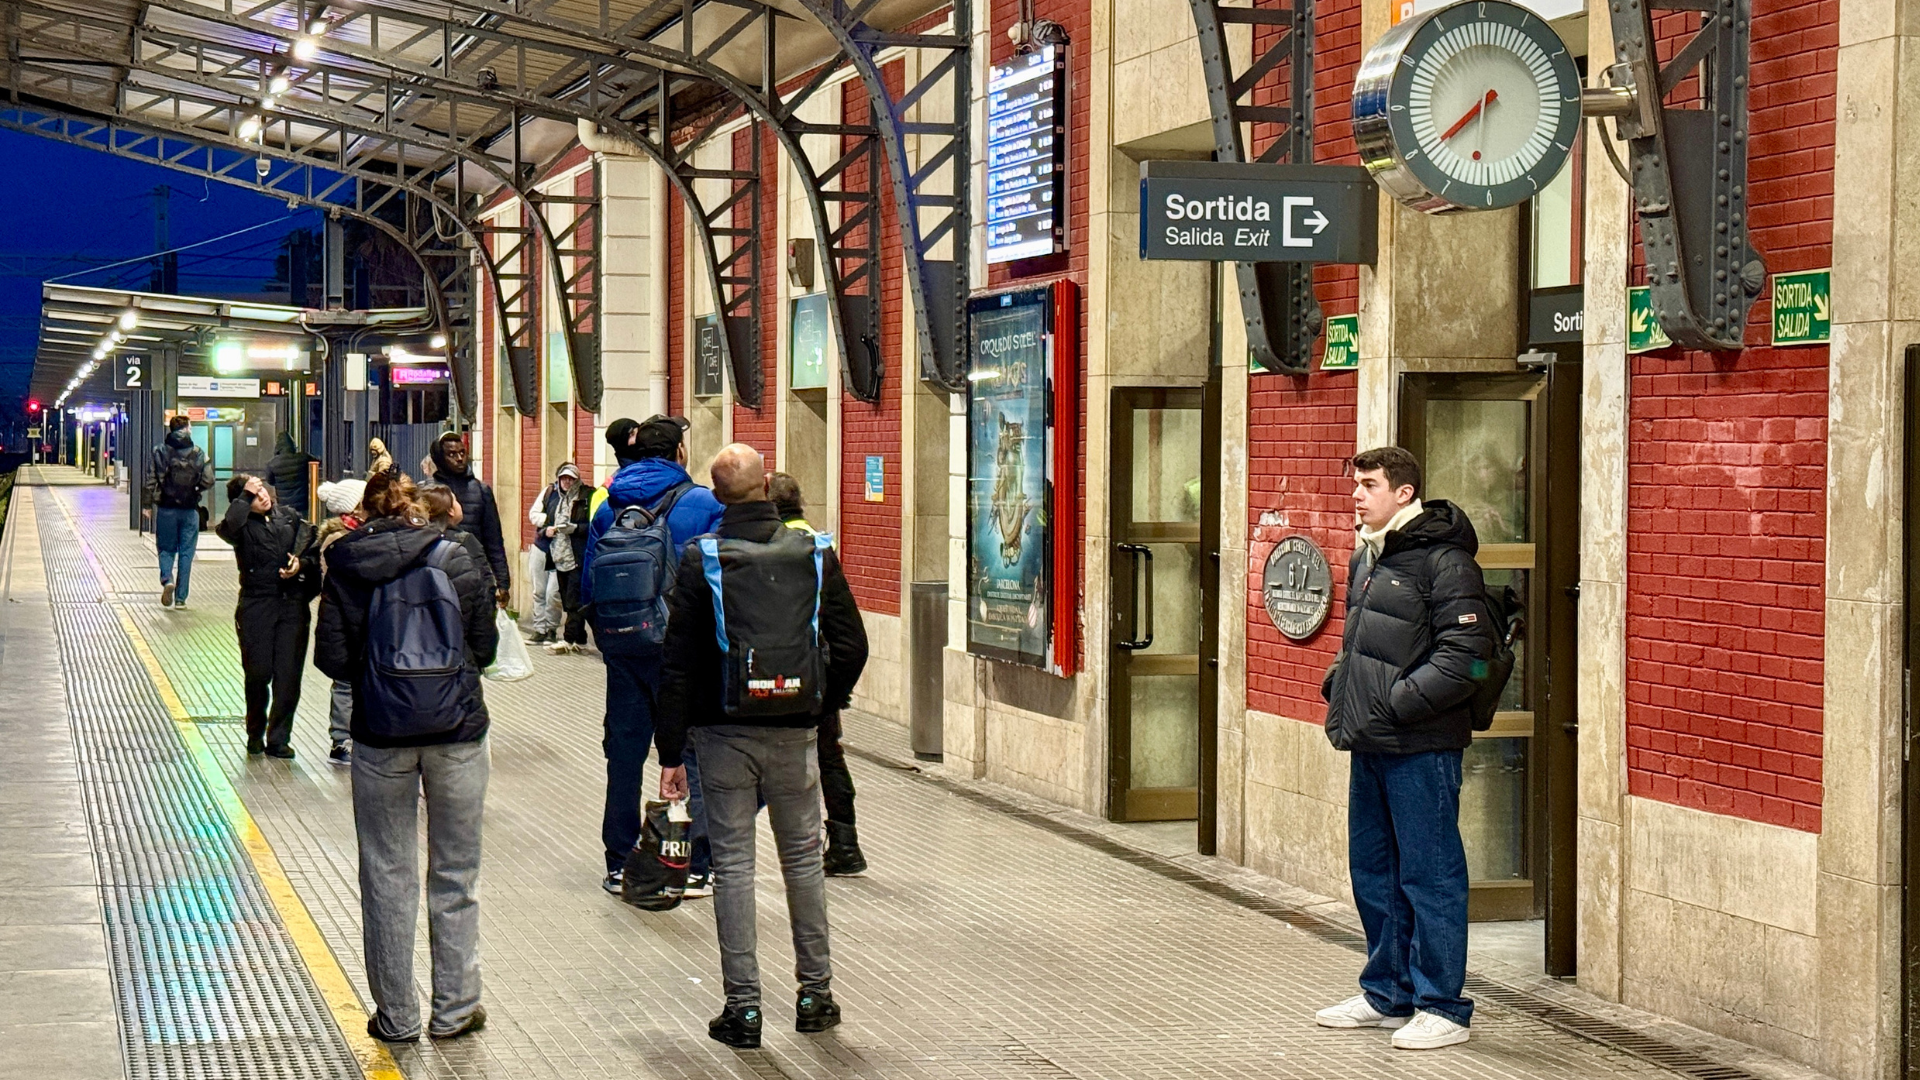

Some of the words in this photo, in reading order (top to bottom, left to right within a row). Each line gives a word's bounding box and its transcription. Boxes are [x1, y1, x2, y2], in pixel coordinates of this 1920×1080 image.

[1478, 1, 1486, 18] 12
[1401, 54, 1416, 67] 10
[1551, 46, 1565, 59] 2
[1390, 104, 1406, 112] 9
[1404, 149, 1418, 161] 8
[1554, 141, 1569, 152] 4
[1440, 180, 1451, 195] 7
[1527, 175, 1538, 190] 5
[1486, 189, 1493, 206] 6
[1166, 193, 1270, 222] Sortida
[1165, 227, 1224, 247] Salida
[1234, 228, 1271, 247] Exit
[1776, 282, 1813, 310] SORTIDA
[1777, 312, 1810, 338] SALIDA
[1328, 324, 1349, 344] SORTIDA
[126, 356, 141, 365] via
[1326, 345, 1347, 365] SALIDA
[126, 366, 142, 387] 2
